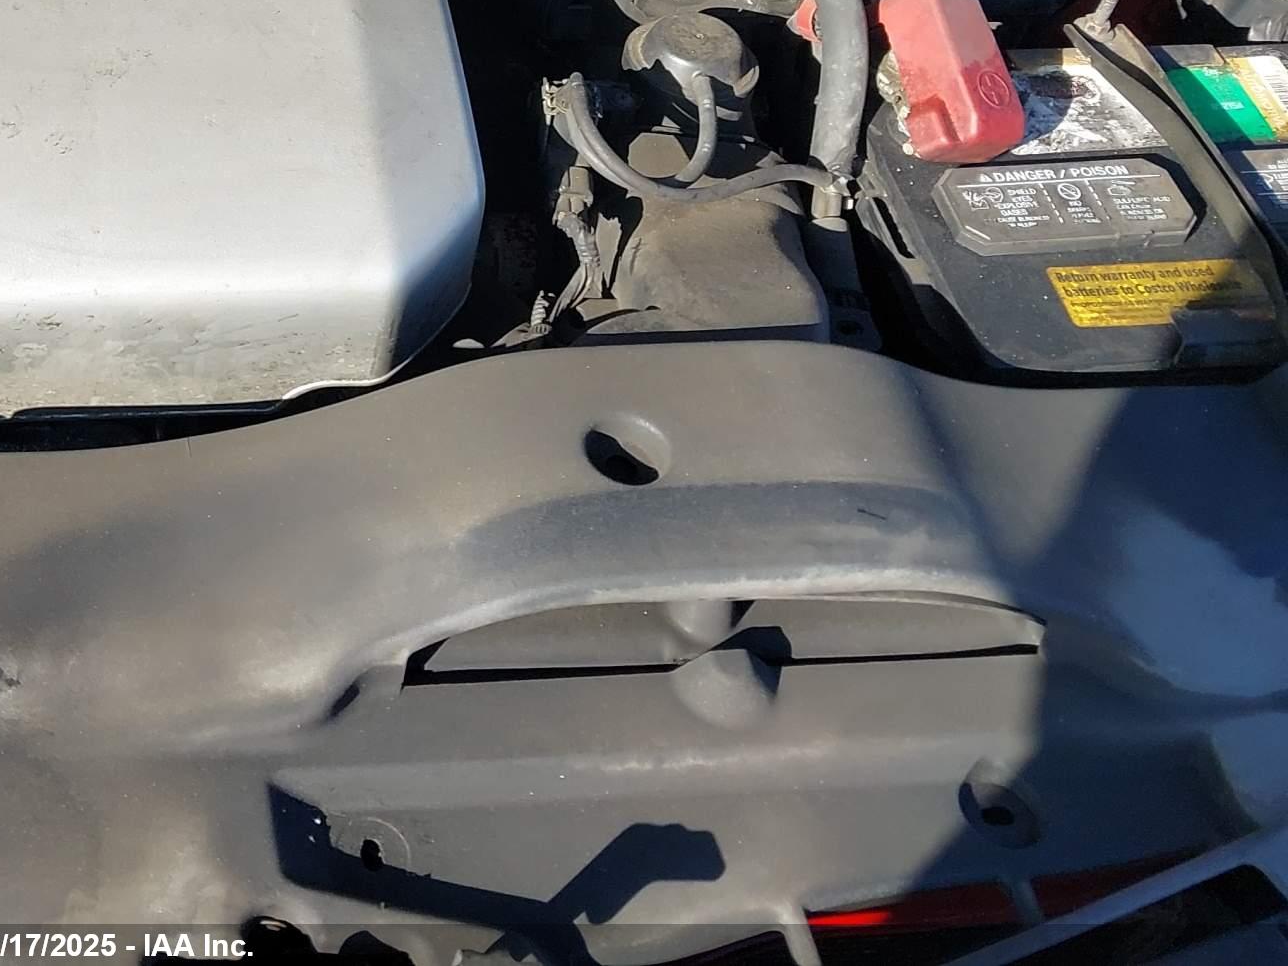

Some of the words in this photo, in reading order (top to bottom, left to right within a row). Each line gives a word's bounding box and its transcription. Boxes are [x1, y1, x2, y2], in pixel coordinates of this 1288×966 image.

[993, 170, 1056, 183] DANGER
[1070, 165, 1129, 178] POISON
[1055, 271, 1099, 284] Return
[1099, 269, 1156, 284] warranty
[1158, 267, 1183, 279] and
[1184, 265, 1214, 277] used
[1063, 284, 1120, 297] batteries
[1121, 284, 1135, 295] to
[1136, 283, 1176, 295] Costco
